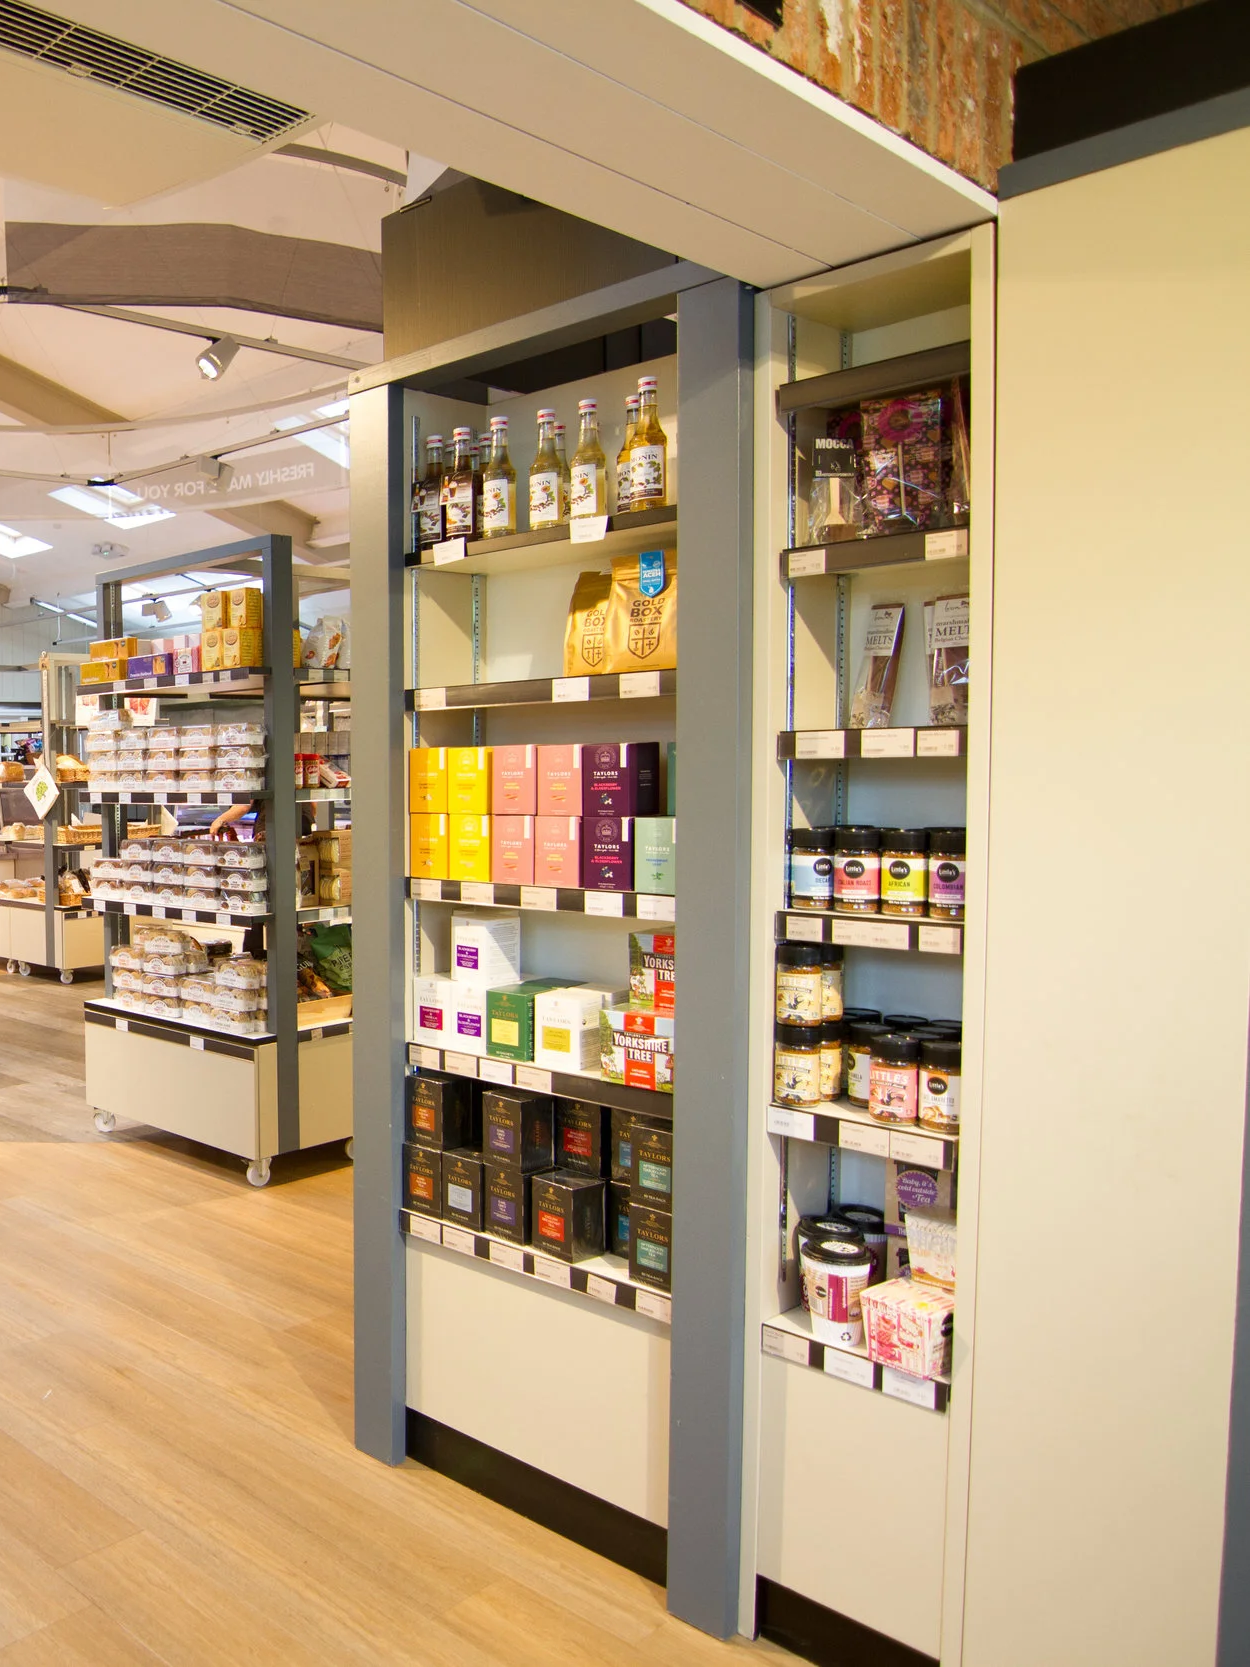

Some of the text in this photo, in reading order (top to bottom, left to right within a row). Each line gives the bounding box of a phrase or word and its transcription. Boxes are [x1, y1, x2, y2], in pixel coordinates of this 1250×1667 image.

[815, 438, 854, 449] MOCCA
[632, 598, 665, 607] GOLD
[587, 609, 604, 617] GOL
[630, 605, 663, 618] BOX
[935, 625, 969, 637] MELT
[866, 634, 894, 646] MELTS
[890, 866, 908, 874] Little's
[938, 868, 956, 876] Little's
[643, 955, 674, 971] YORKS
[658, 969, 675, 982] TRE
[492, 1009, 518, 1018] TAYLORS
[613, 1031, 668, 1053] YORKSHIRE
[627, 1049, 653, 1062] TREE
[929, 1081, 945, 1090] Little's
[412, 1096, 435, 1106] TAYLORS
[489, 1115, 514, 1127] TAYLORS
[564, 1117, 592, 1129] TAYLORS
[638, 1150, 671, 1162] TAYLORS
[410, 1164, 434, 1175] TAYLORS
[448, 1174, 472, 1185] TAYLORS
[902, 1178, 921, 1187] Baby,
[490, 1185, 515, 1198] TAYLORS
[911, 1187, 936, 1195] outside
[916, 1193, 931, 1203] Tea
[538, 1200, 564, 1214] TAYLORS
[636, 1227, 669, 1242] TAYLORS
